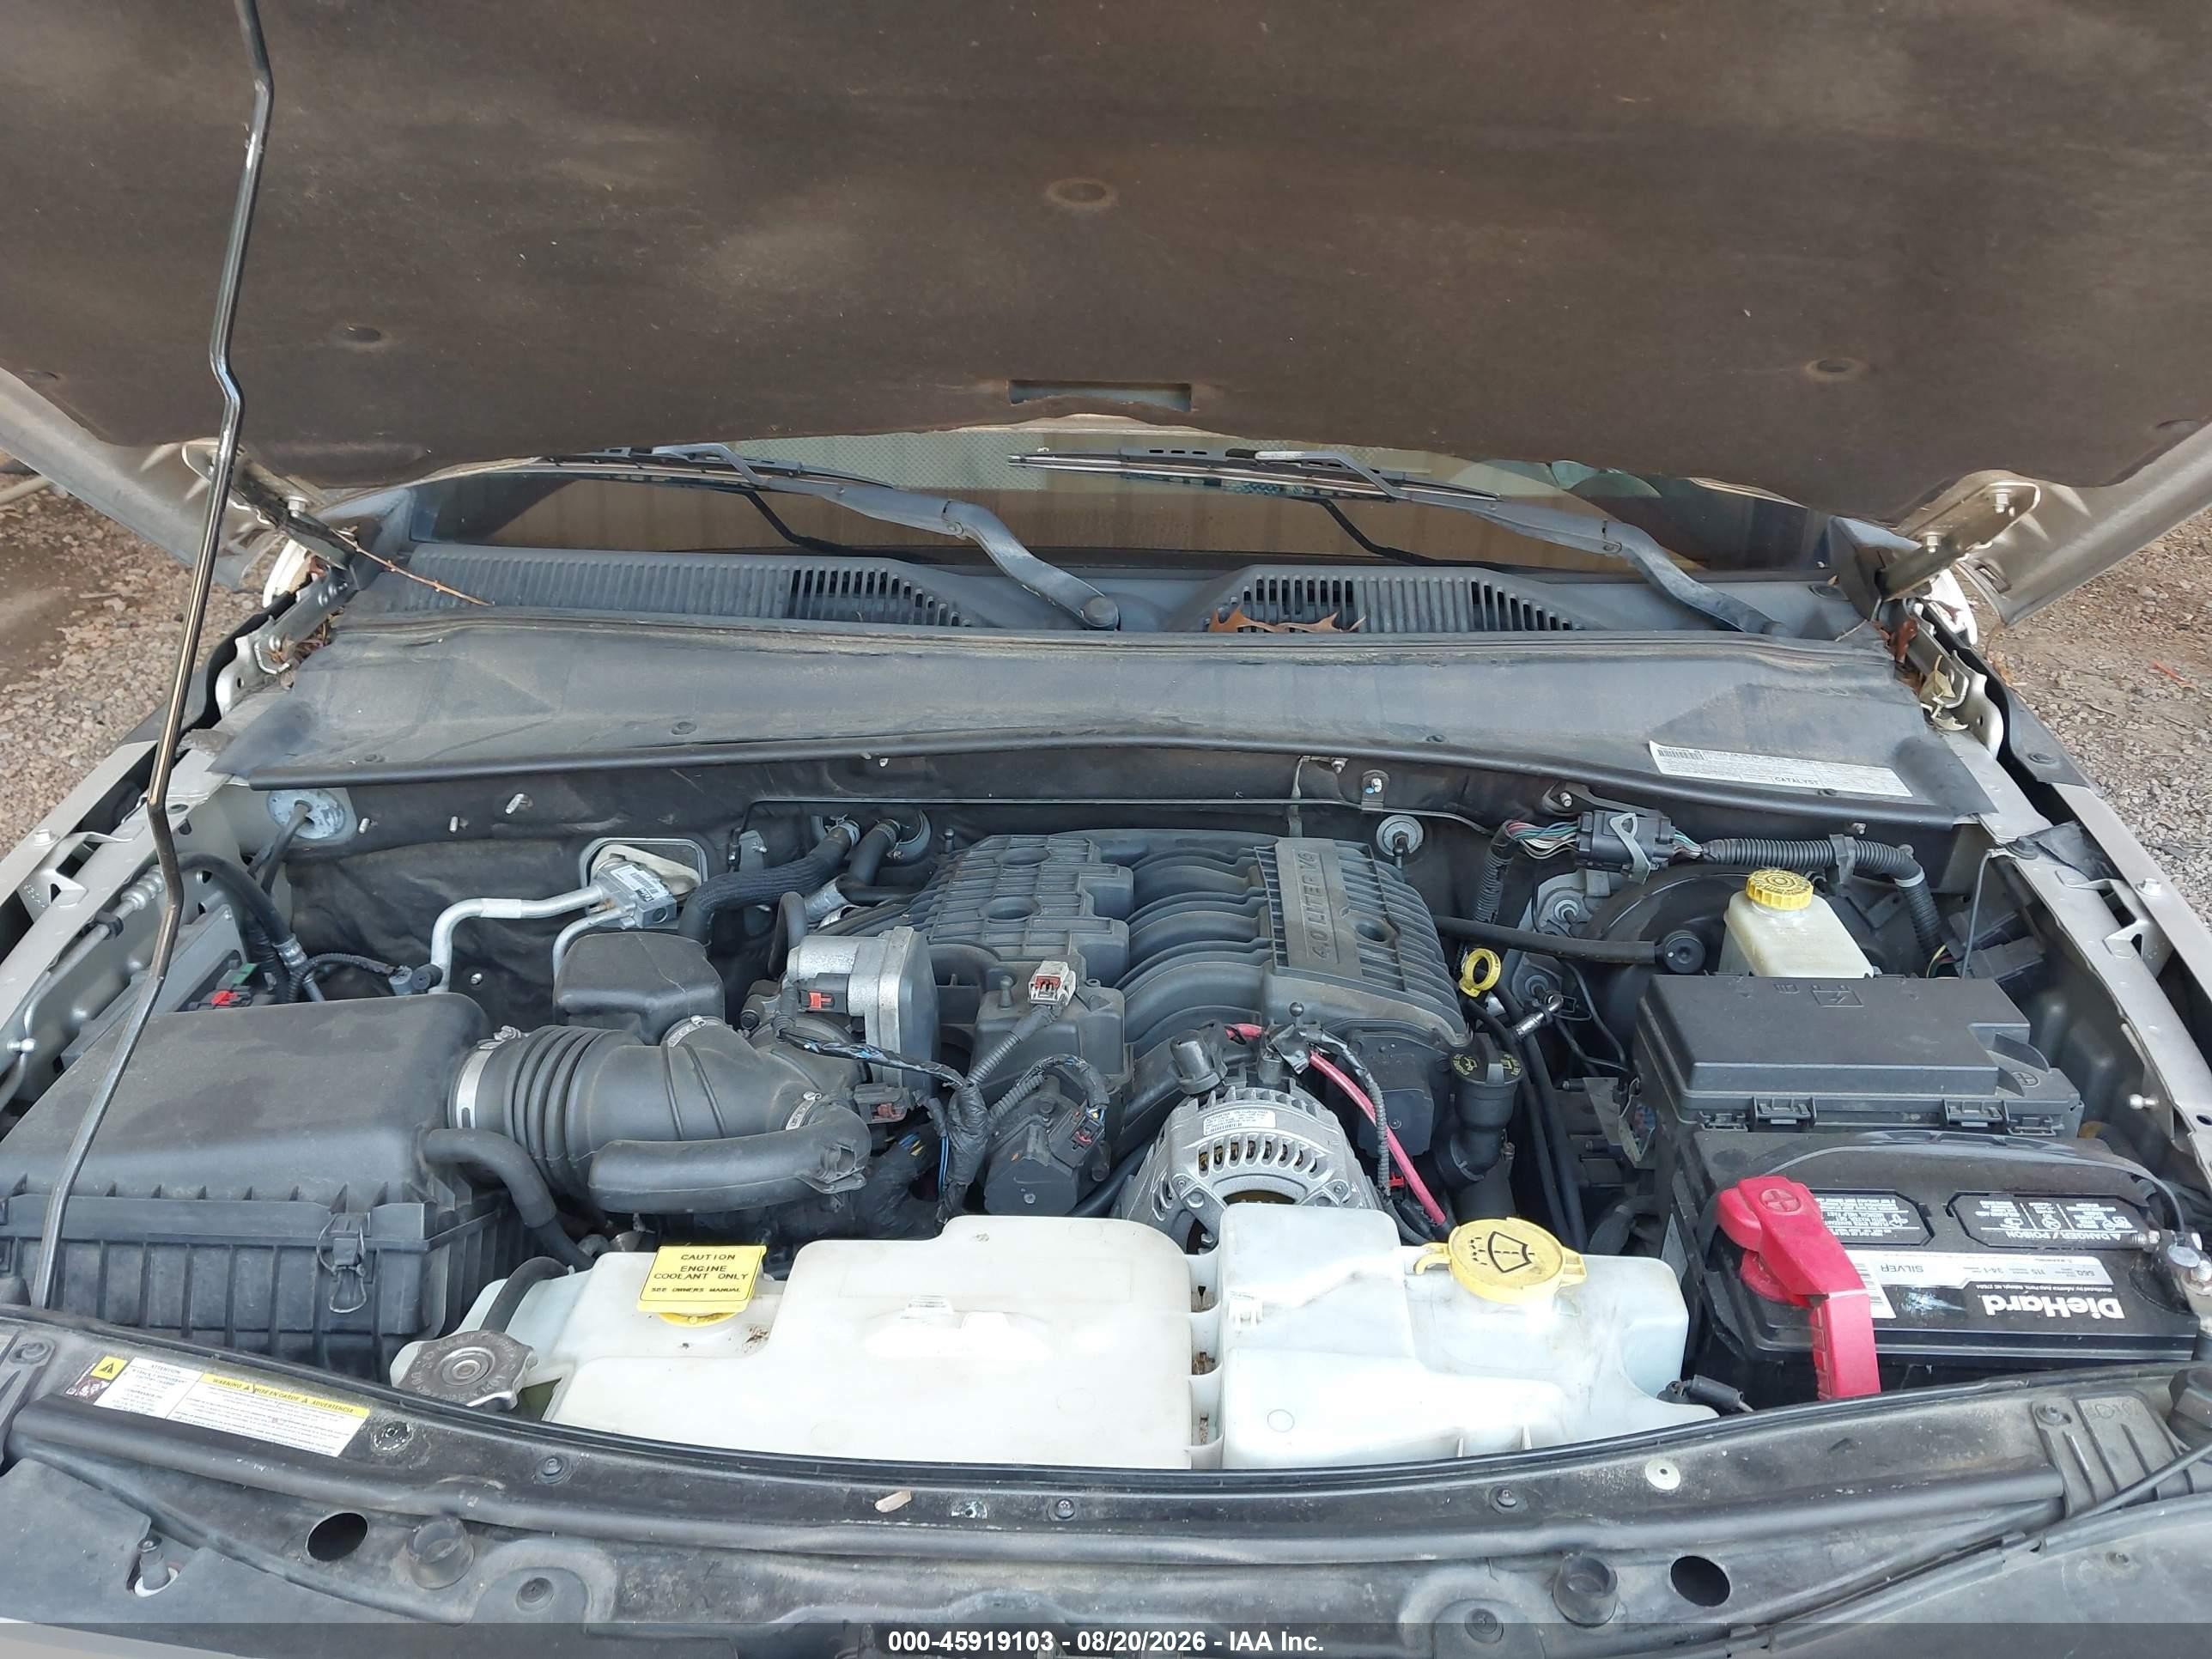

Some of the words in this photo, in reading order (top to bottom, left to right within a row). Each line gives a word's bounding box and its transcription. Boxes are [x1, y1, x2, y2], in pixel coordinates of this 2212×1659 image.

[1774, 776, 1820, 785] CATALYST
[1302, 875, 1328, 926] LITER
[2005, 1231, 2051, 1239] POISON
[2061, 1232, 2112, 1241] DANGER
[1881, 1263, 1924, 1273] SILVER
[1982, 1294, 2125, 1320] DieHard
[212, 1377, 243, 1389] WARNING
